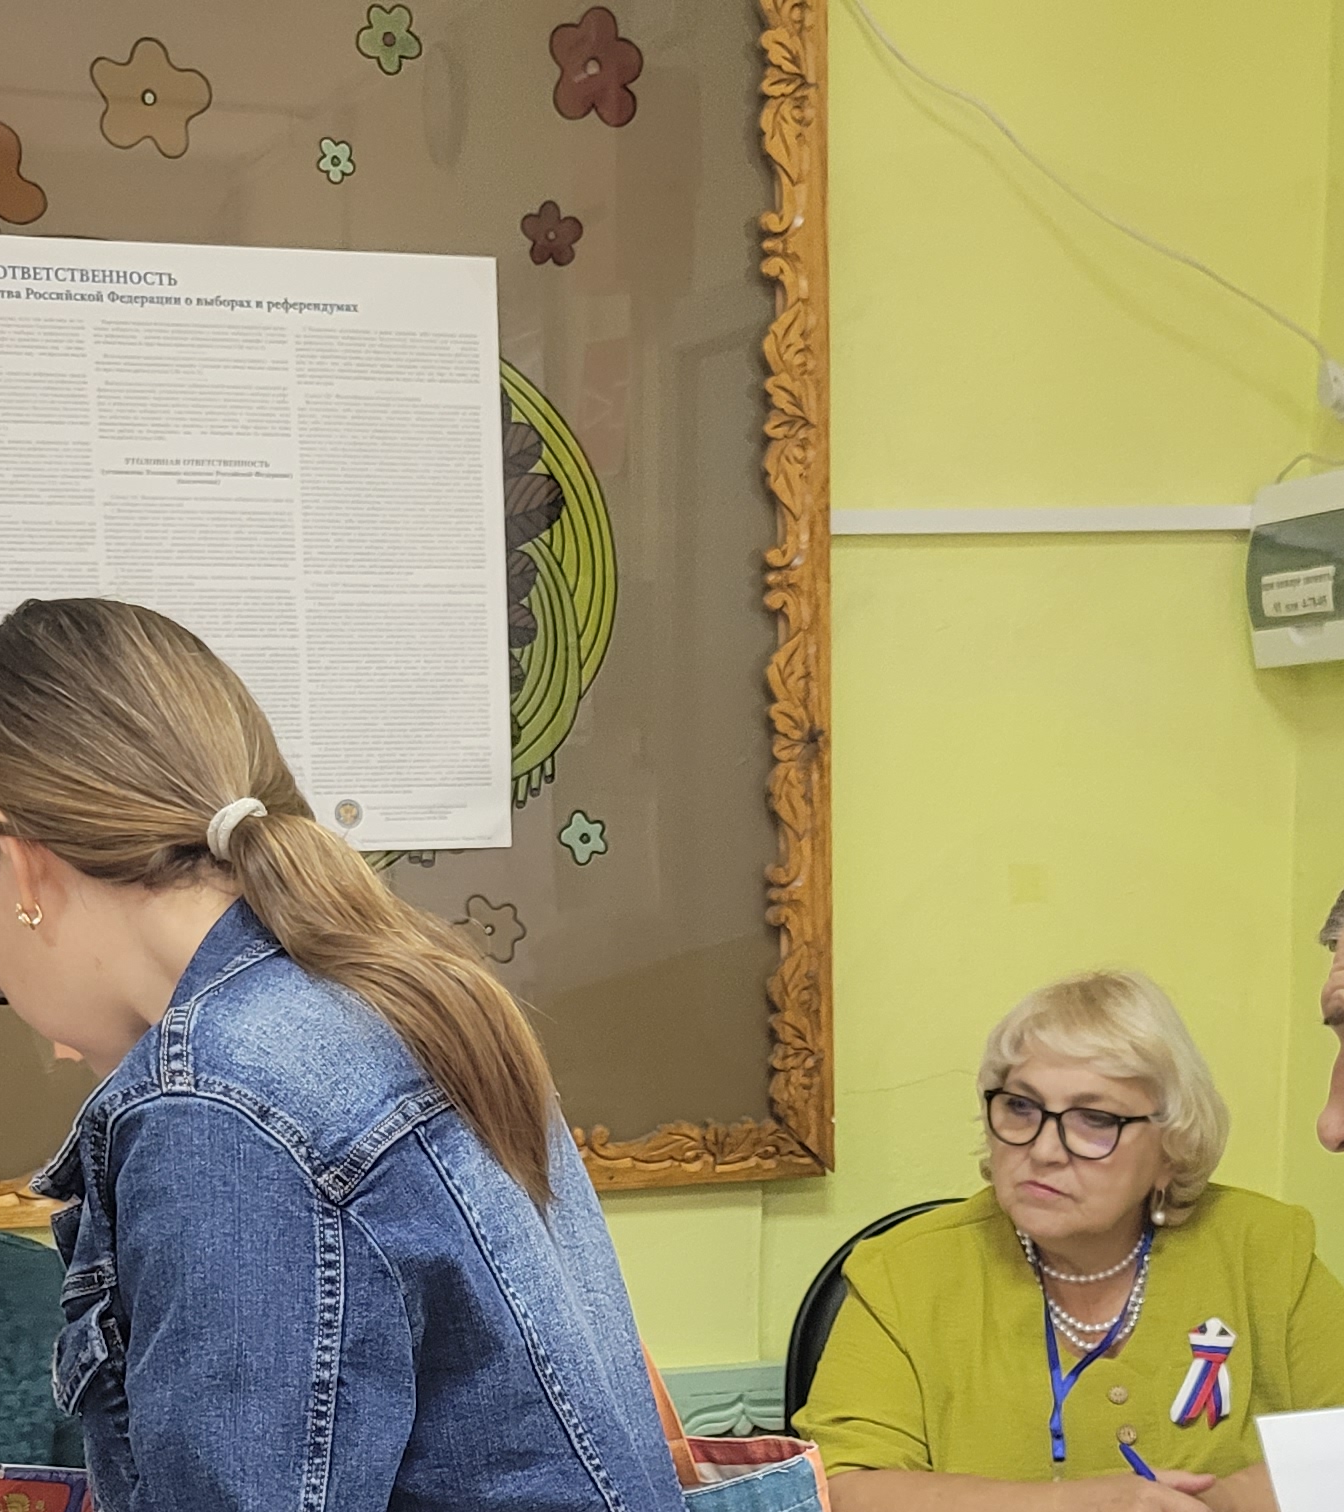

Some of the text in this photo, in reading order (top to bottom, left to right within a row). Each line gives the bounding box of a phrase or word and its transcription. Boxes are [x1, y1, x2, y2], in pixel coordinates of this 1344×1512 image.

[26, 287, 104, 303] Российской
[107, 290, 182, 307] Федерации
[185, 297, 193, 306] о
[196, 295, 252, 310] выборах
[255, 299, 263, 309] и
[266, 297, 359, 316] референдумах
